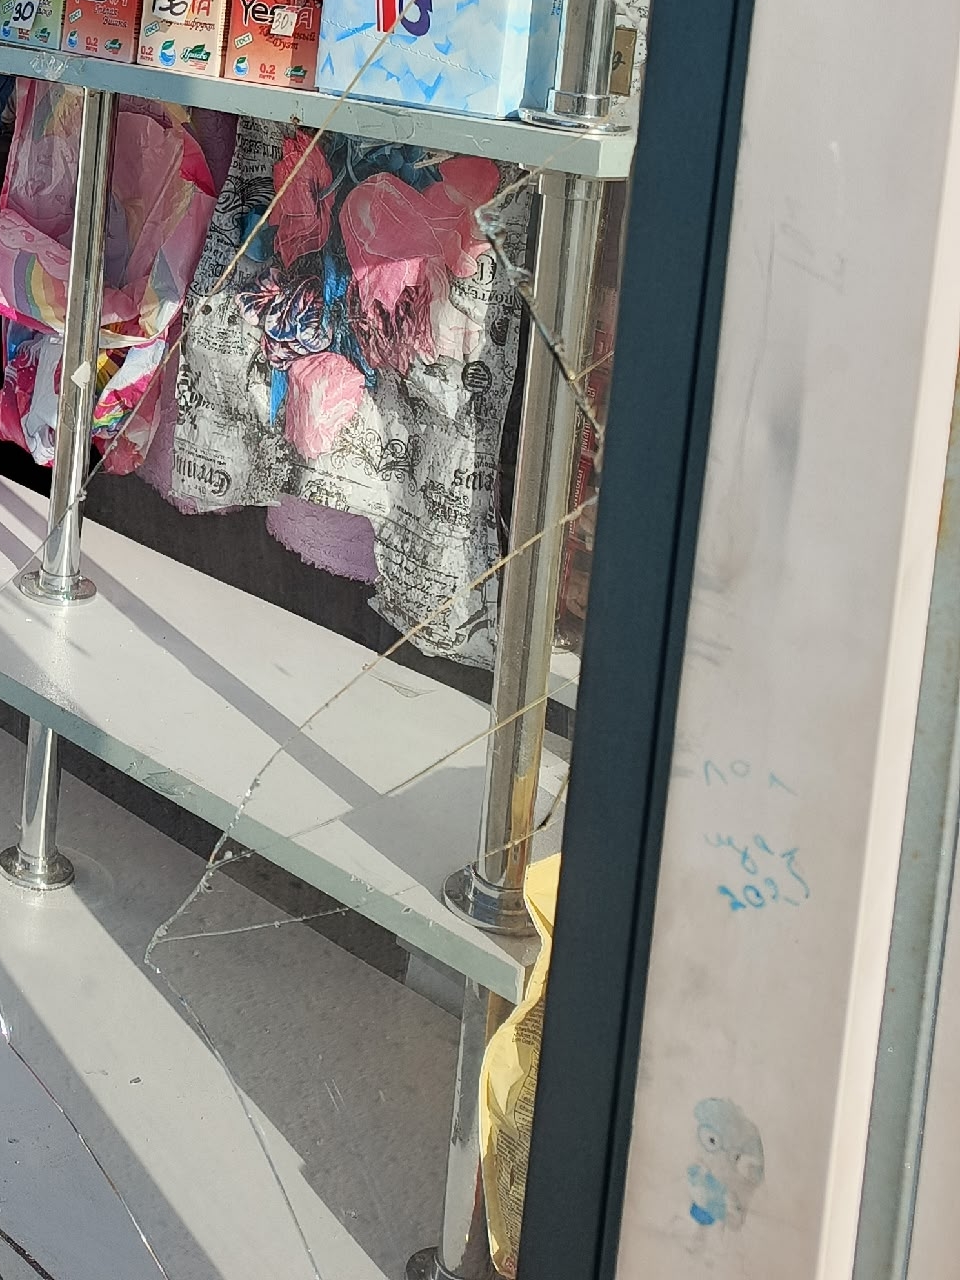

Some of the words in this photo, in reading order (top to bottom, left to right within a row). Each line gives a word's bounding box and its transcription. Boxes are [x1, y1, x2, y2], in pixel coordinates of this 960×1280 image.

[144, 23, 160, 35] ГОСТ
[86, 36, 99, 47] 0.2
[234, 34, 253, 48] ГОСТ
[140, 45, 154, 56] 0.2
[259, 63, 276, 75] 0.2
